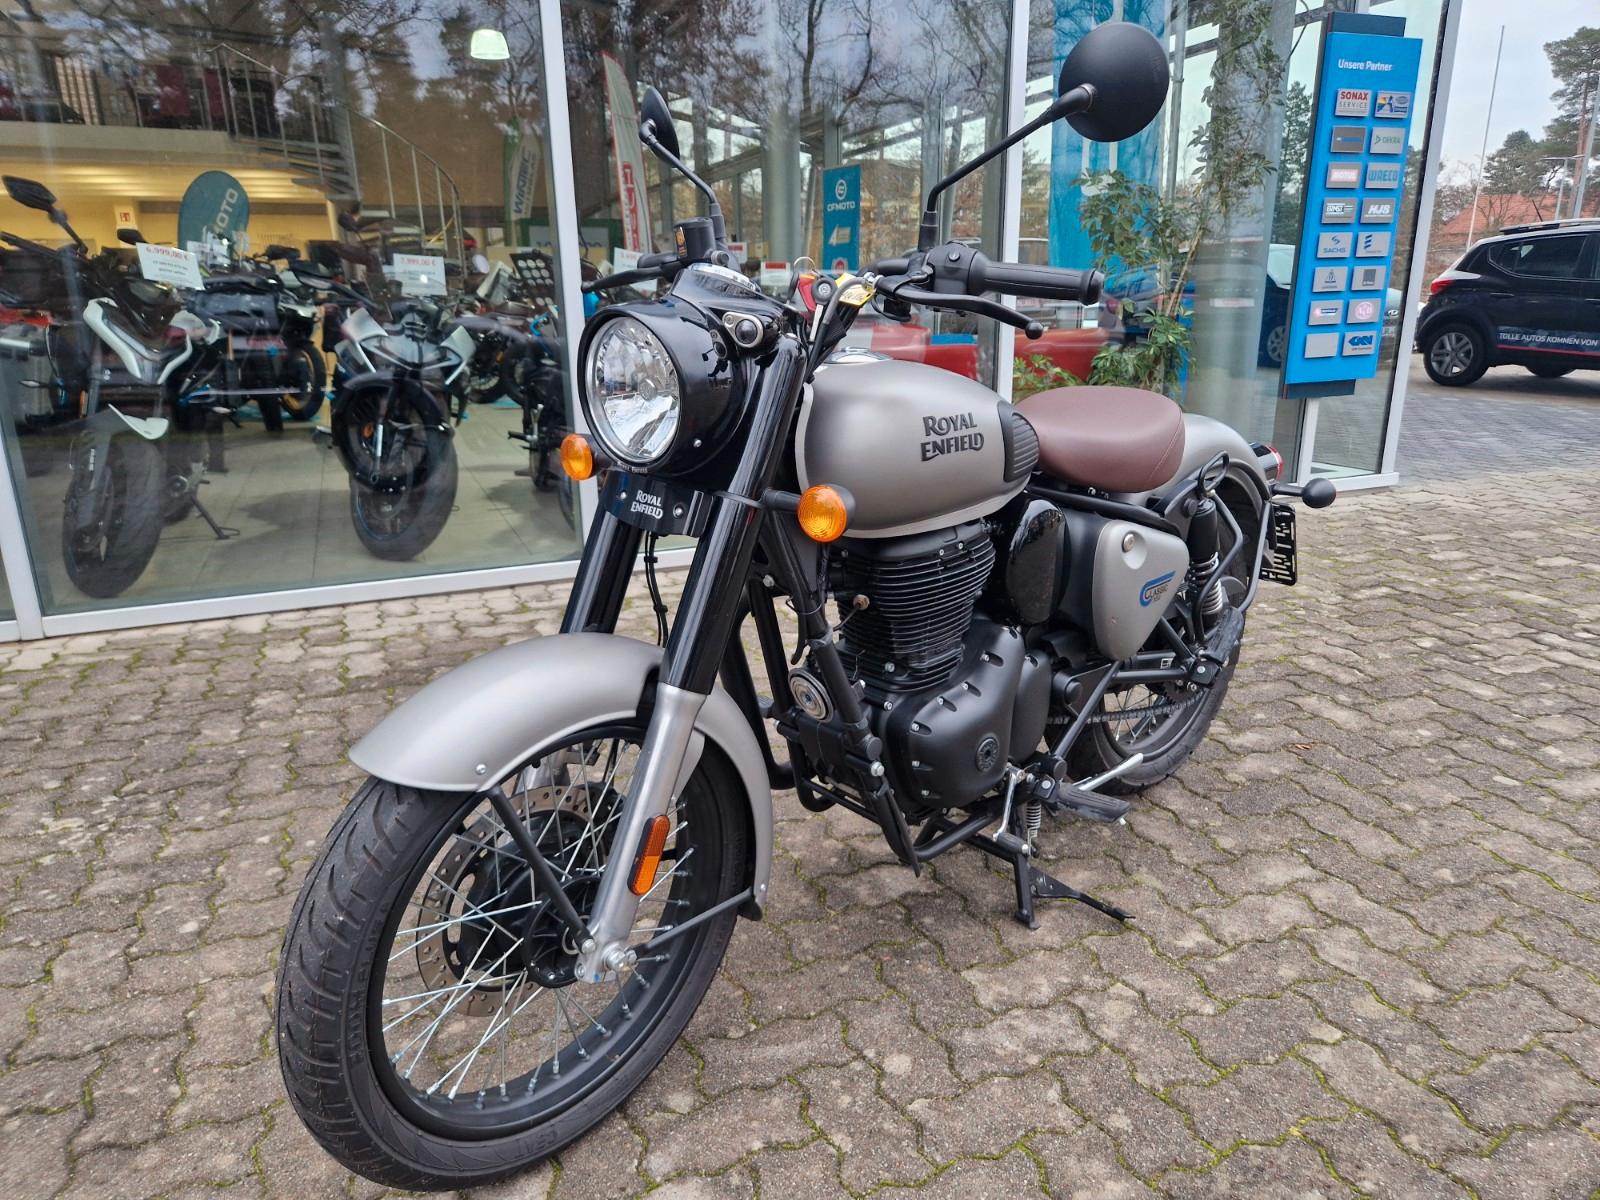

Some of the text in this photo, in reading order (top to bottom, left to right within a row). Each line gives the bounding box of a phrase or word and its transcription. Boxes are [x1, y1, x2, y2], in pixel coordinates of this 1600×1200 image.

[1338, 58, 1393, 71] Unsere Partner
[1340, 91, 1369, 101] SONAX
[1339, 101, 1368, 109] SERVICE
[826, 200, 856, 212] CFMOTO
[1368, 204, 1391, 214] HJS
[1499, 332, 1599, 347] TOLLE AUTOS KOMMEN VON
[922, 412, 978, 437] ROYAL
[920, 432, 985, 462] ENFIELD
[636, 489, 662, 507] ROYAL
[630, 501, 664, 519] ENFIELD
